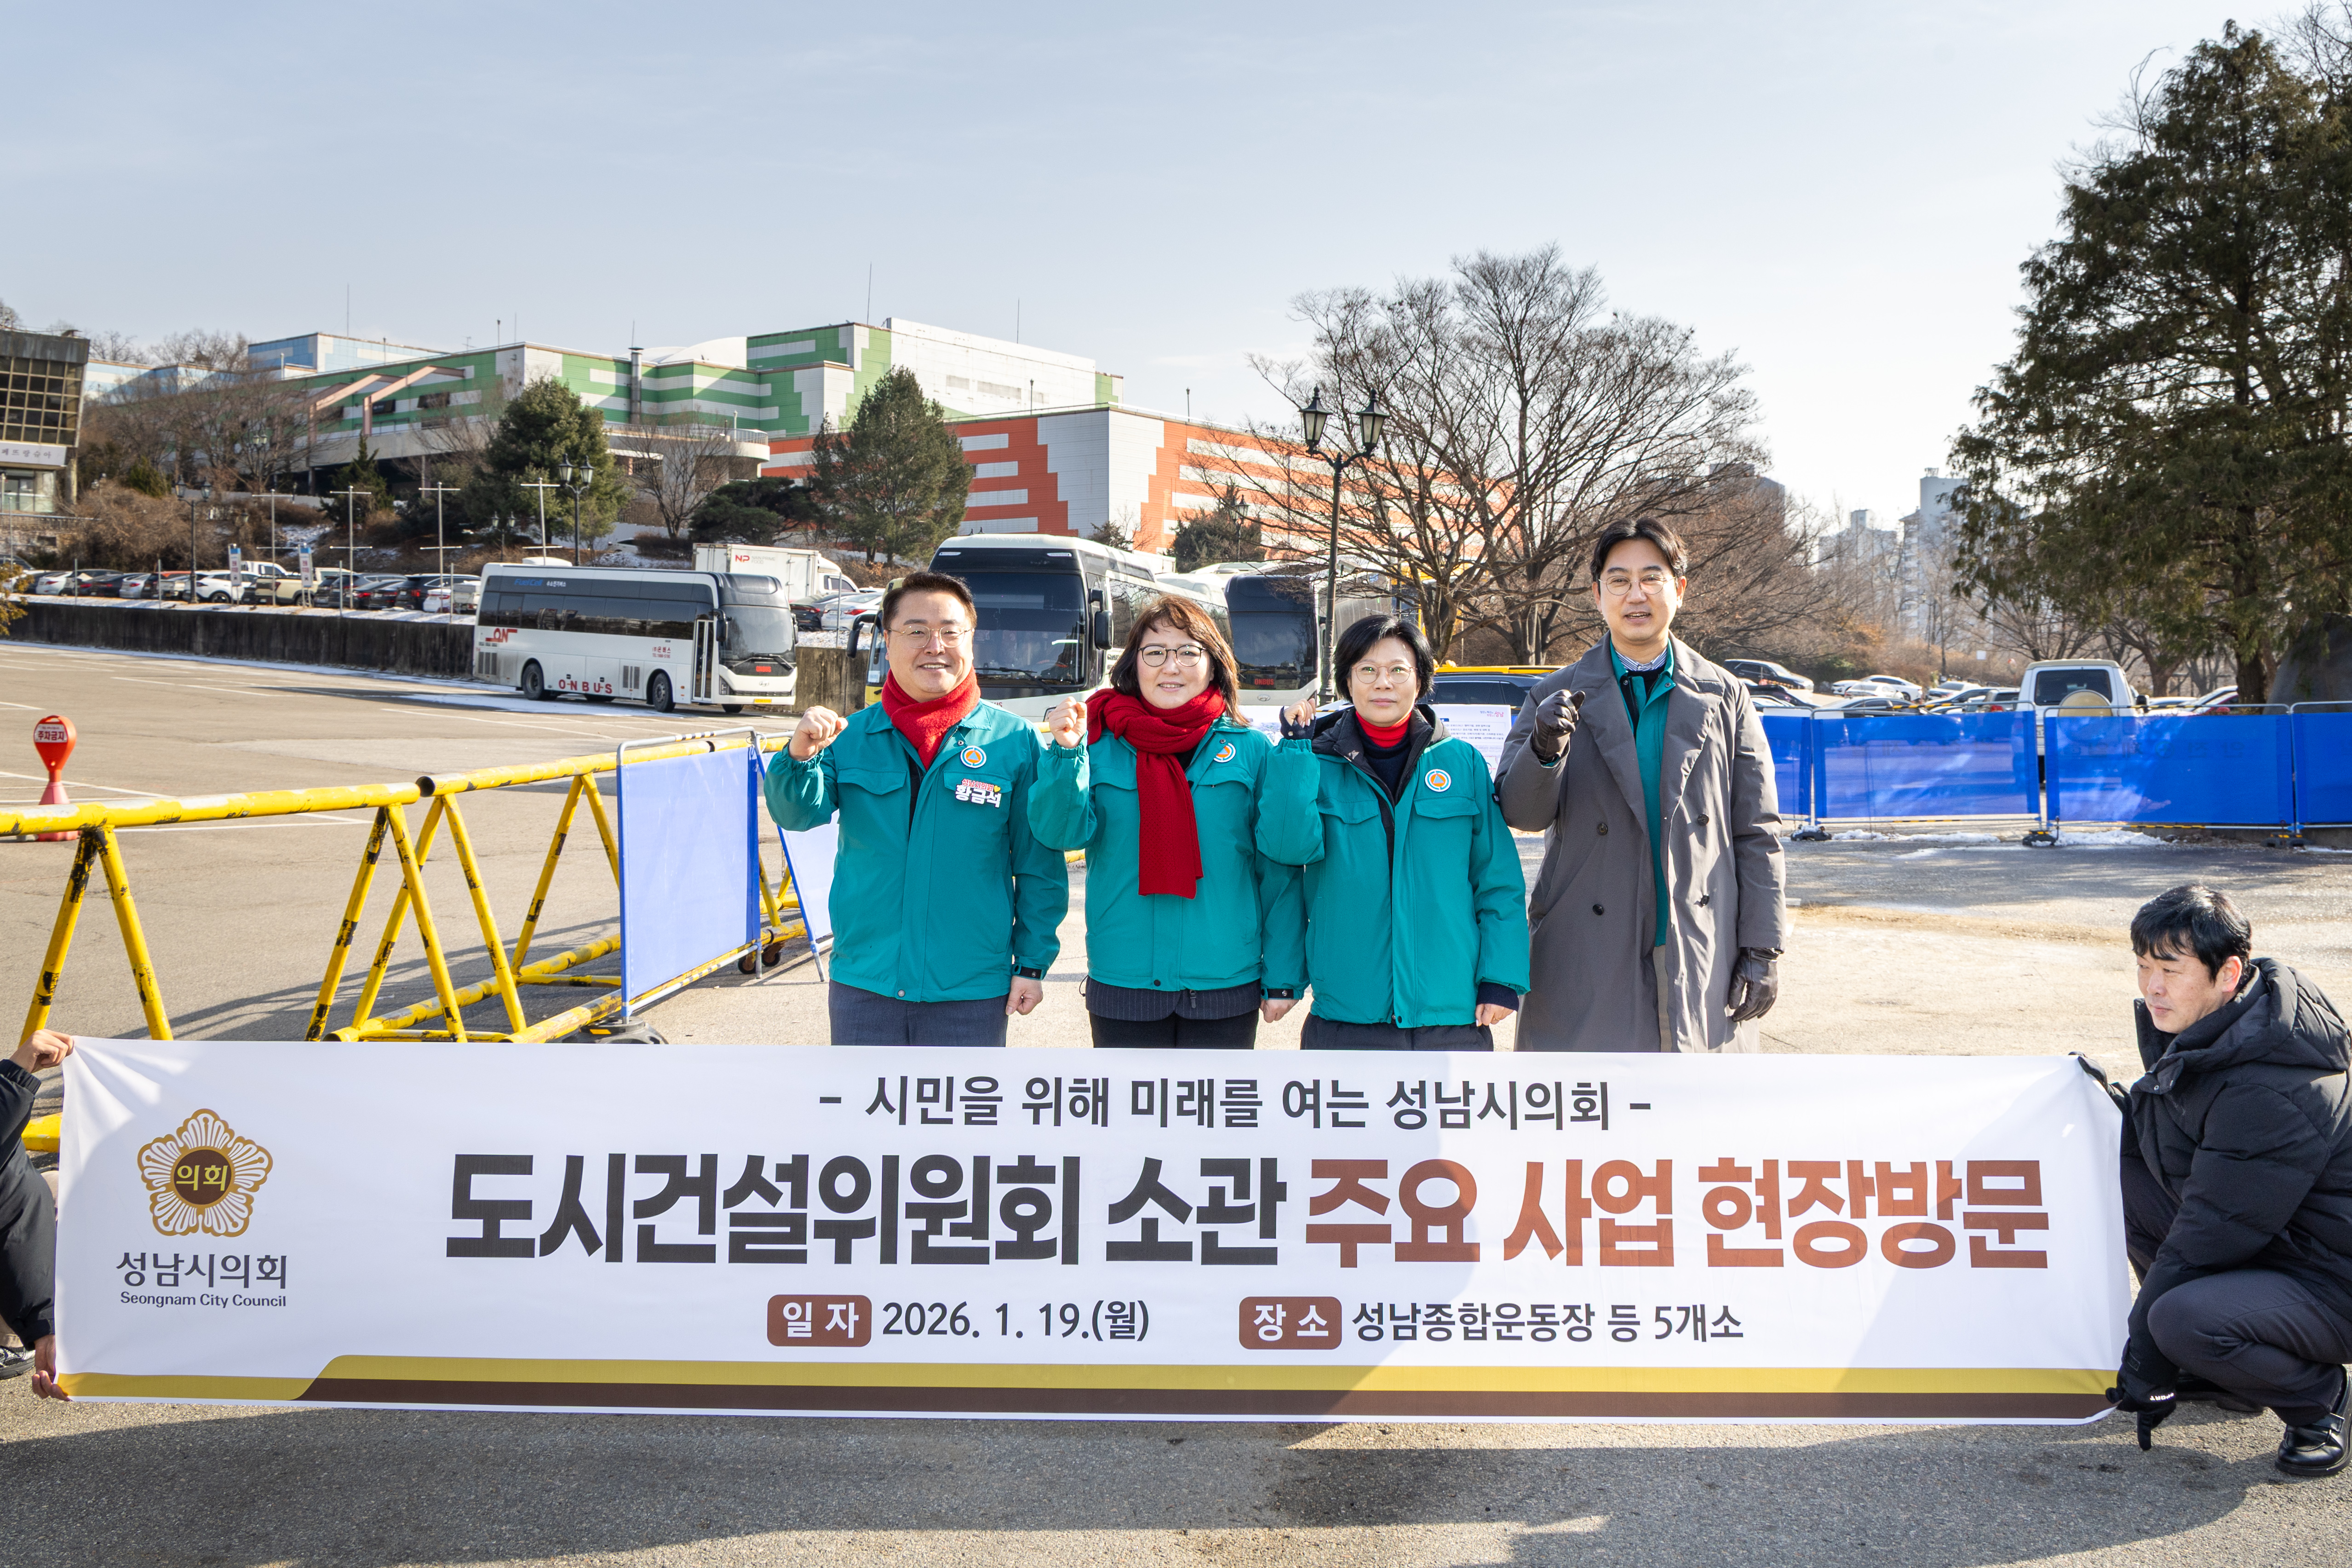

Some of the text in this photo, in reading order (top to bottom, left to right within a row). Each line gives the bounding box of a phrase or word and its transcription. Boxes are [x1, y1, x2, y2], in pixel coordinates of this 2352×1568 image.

[38, 731, 64, 741] 주차금지
[955, 785, 1002, 808] 황금석
[962, 779, 994, 792] 성남시의원
[866, 1076, 1003, 1126] 시민을
[1023, 1078, 1109, 1127] 위해
[1132, 1079, 1263, 1128] 미래를
[1283, 1080, 1369, 1129] 여는
[1387, 1081, 1608, 1131] 성남시의회
[176, 1164, 229, 1191] 의회
[447, 1154, 2049, 1269] 도시건설위원회 소관 주요 사업 현장방문
[116, 1252, 287, 1289] 성남시의회
[120, 1291, 286, 1309] Seongnam City Council
[883, 1301, 980, 1338] 2026.
[1352, 1302, 1595, 1342] 성남종합운동장
[1607, 1304, 1641, 1343] 등
[1655, 1304, 1744, 1342] 5개소
